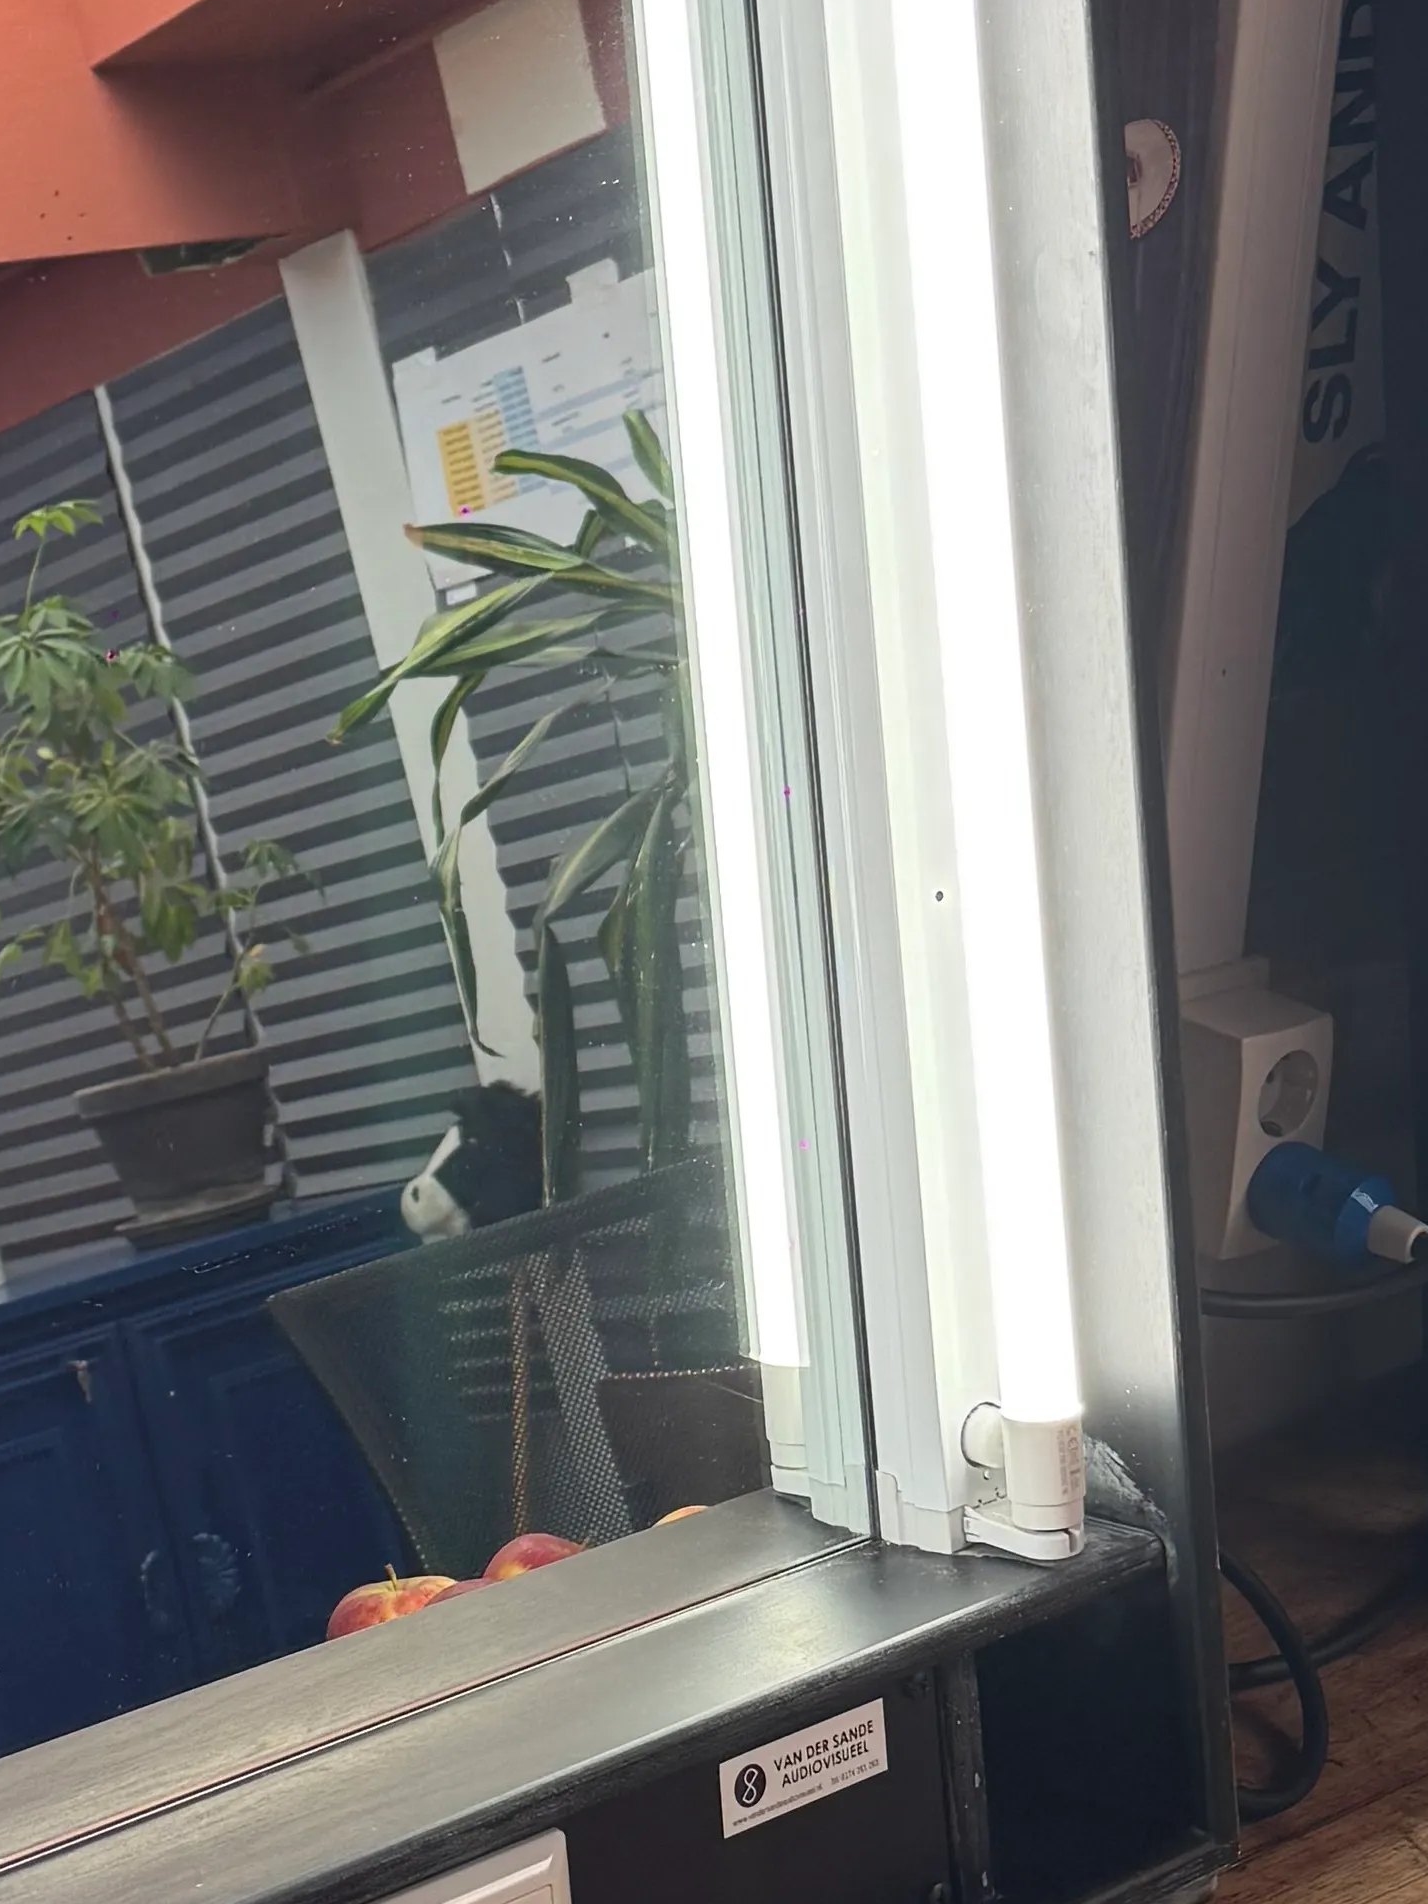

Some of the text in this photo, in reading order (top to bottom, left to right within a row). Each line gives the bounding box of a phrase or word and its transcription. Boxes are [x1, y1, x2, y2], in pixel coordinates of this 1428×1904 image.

[1303, 256, 1362, 444] SLY
[773, 1719, 875, 1773] VAN DER SANDE
[781, 1739, 870, 1788] AUDIOVISUEEL
